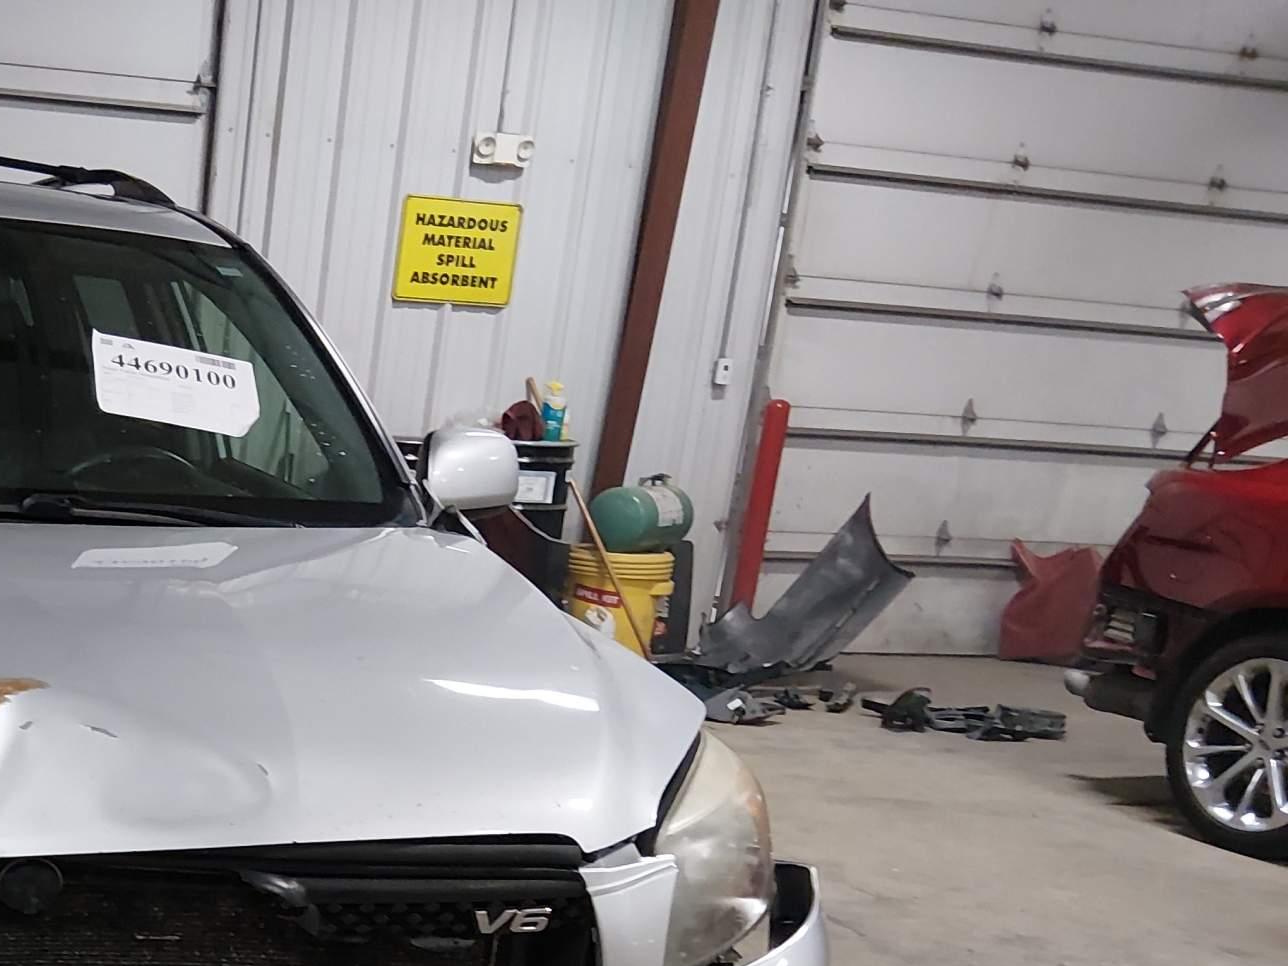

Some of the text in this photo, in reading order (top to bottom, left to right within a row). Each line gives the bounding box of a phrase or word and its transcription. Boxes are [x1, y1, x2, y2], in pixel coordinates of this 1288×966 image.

[415, 213, 508, 232] HAZARDOUS
[422, 233, 495, 250] MATERIAL
[436, 254, 476, 268] SPILL
[410, 271, 498, 289] ABSORBENT
[111, 354, 236, 390] 44690100
[475, 907, 552, 934] V6
